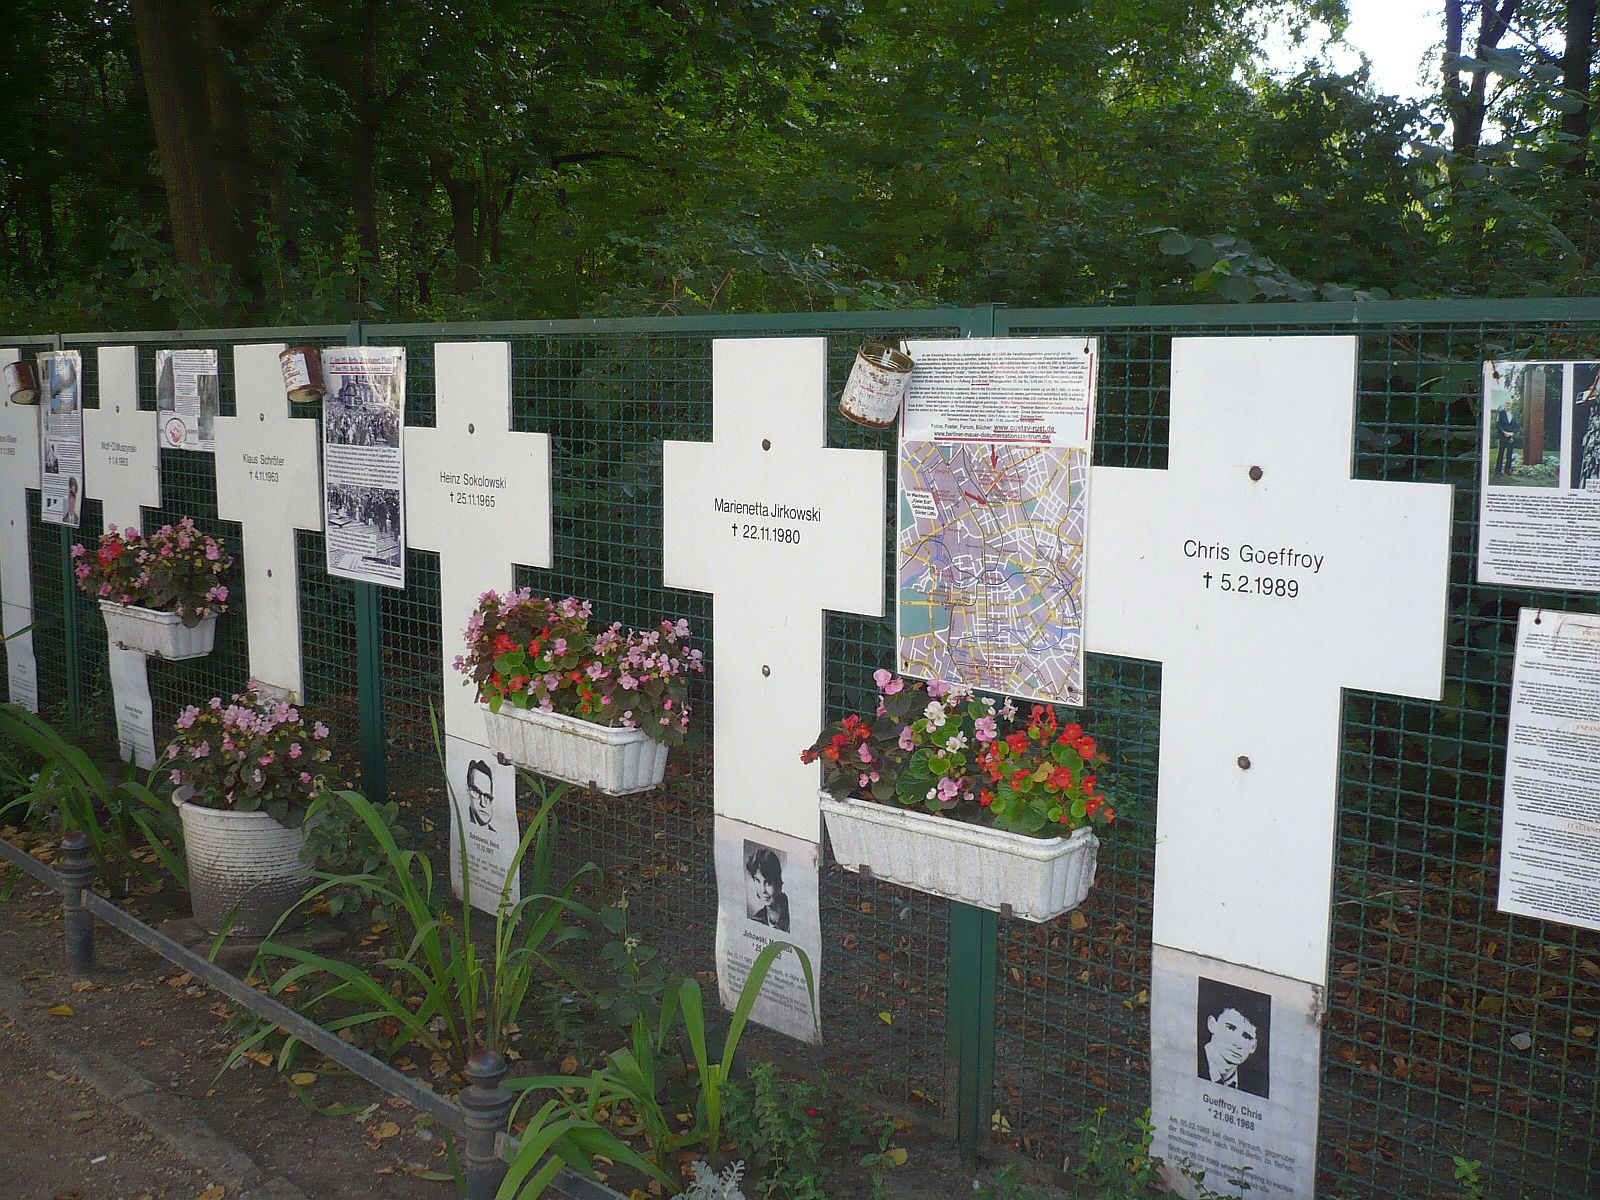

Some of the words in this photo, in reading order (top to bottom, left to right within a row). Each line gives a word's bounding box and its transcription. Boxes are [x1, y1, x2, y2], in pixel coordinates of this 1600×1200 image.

[242, 453, 258, 465] Klaus
[439, 470, 461, 485] Heinz
[463, 473, 507, 490] Sokolowski
[456, 492, 496, 508] 25.11.1965
[714, 497, 769, 517] Marienetta
[771, 503, 821, 522] Jirkowski
[743, 524, 801, 544] 22.11.1980
[1183, 539, 1230, 561] Chris
[1239, 544, 1324, 574] Goeffroy
[1221, 573, 1299, 598] 5.2.1989
[1202, 1093, 1240, 1115] Gueffroy,
[1240, 1105, 1263, 1122] Chris
[1213, 1109, 1256, 1132] 21.06.1968
